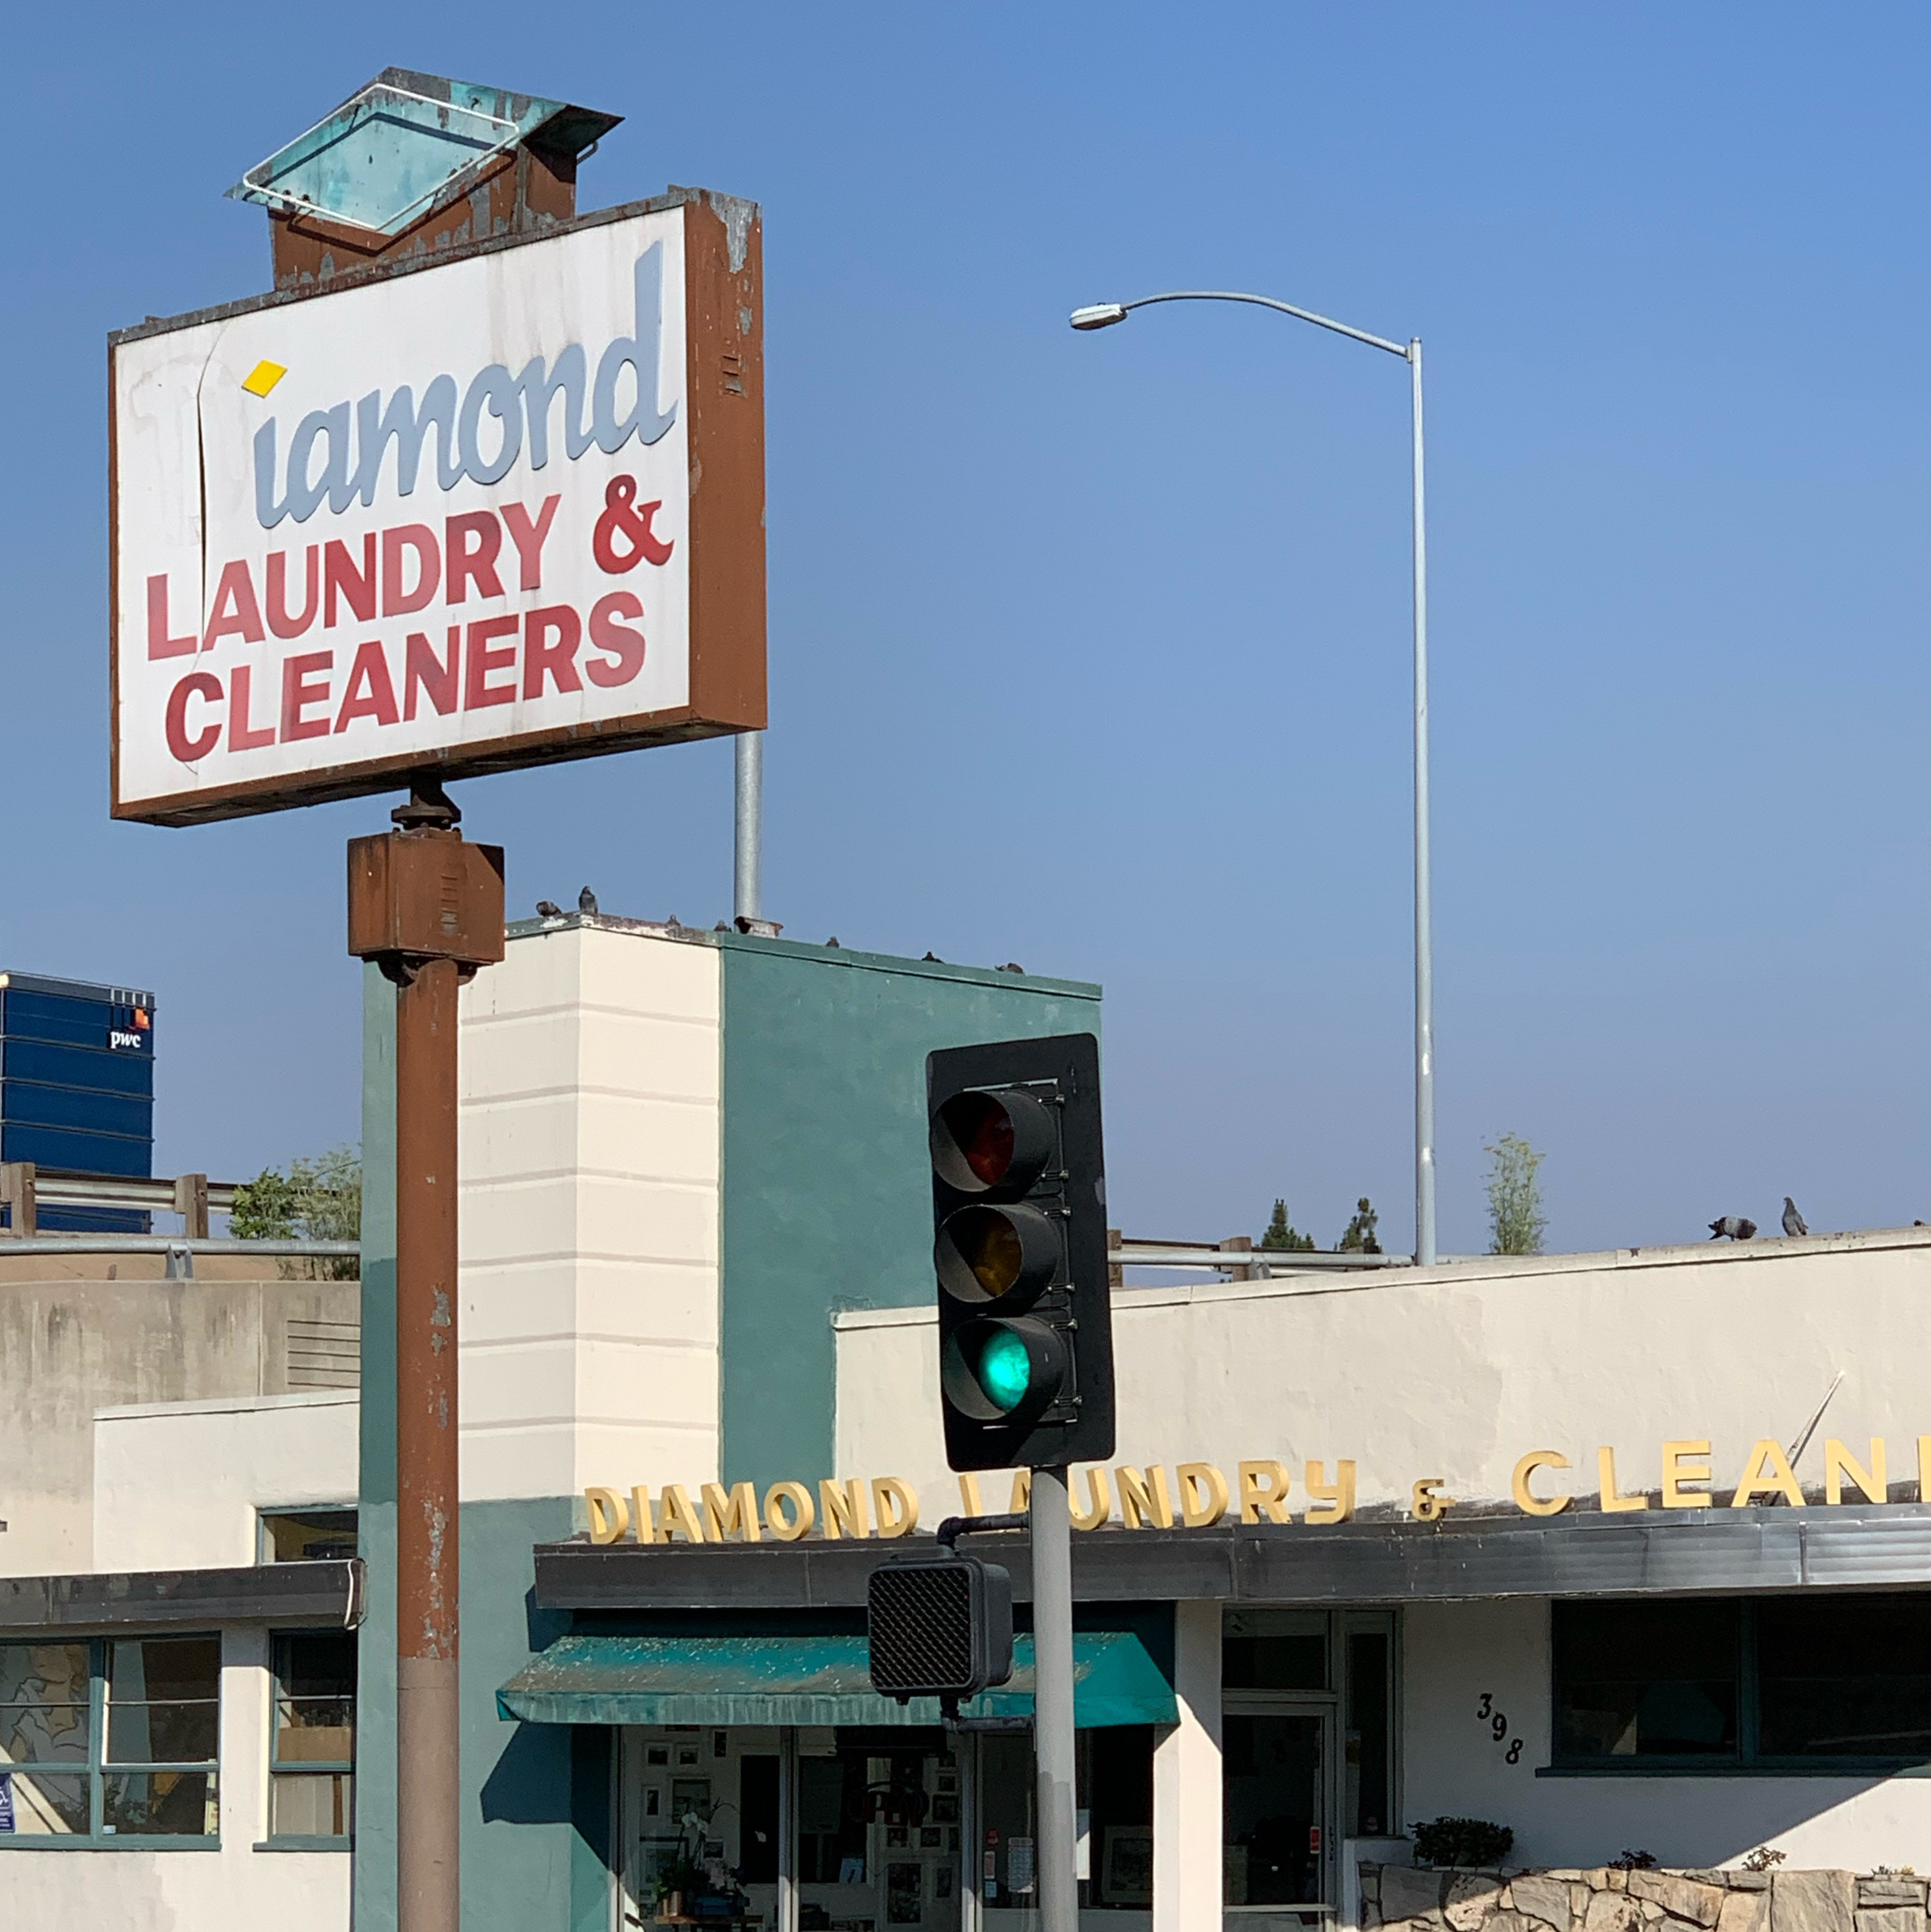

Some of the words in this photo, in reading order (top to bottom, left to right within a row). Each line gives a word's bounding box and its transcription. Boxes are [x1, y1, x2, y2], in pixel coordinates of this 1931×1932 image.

[146, 493, 562, 661] LAUNDRY
[593, 474, 674, 575] &
[165, 591, 646, 763] CLEANERS
[109, 1031, 141, 1049] pwc
[584, 1476, 918, 1545] DIAMOND
[1411, 1478, 1456, 1522] &
[1477, 1693, 1523, 1764] 398
